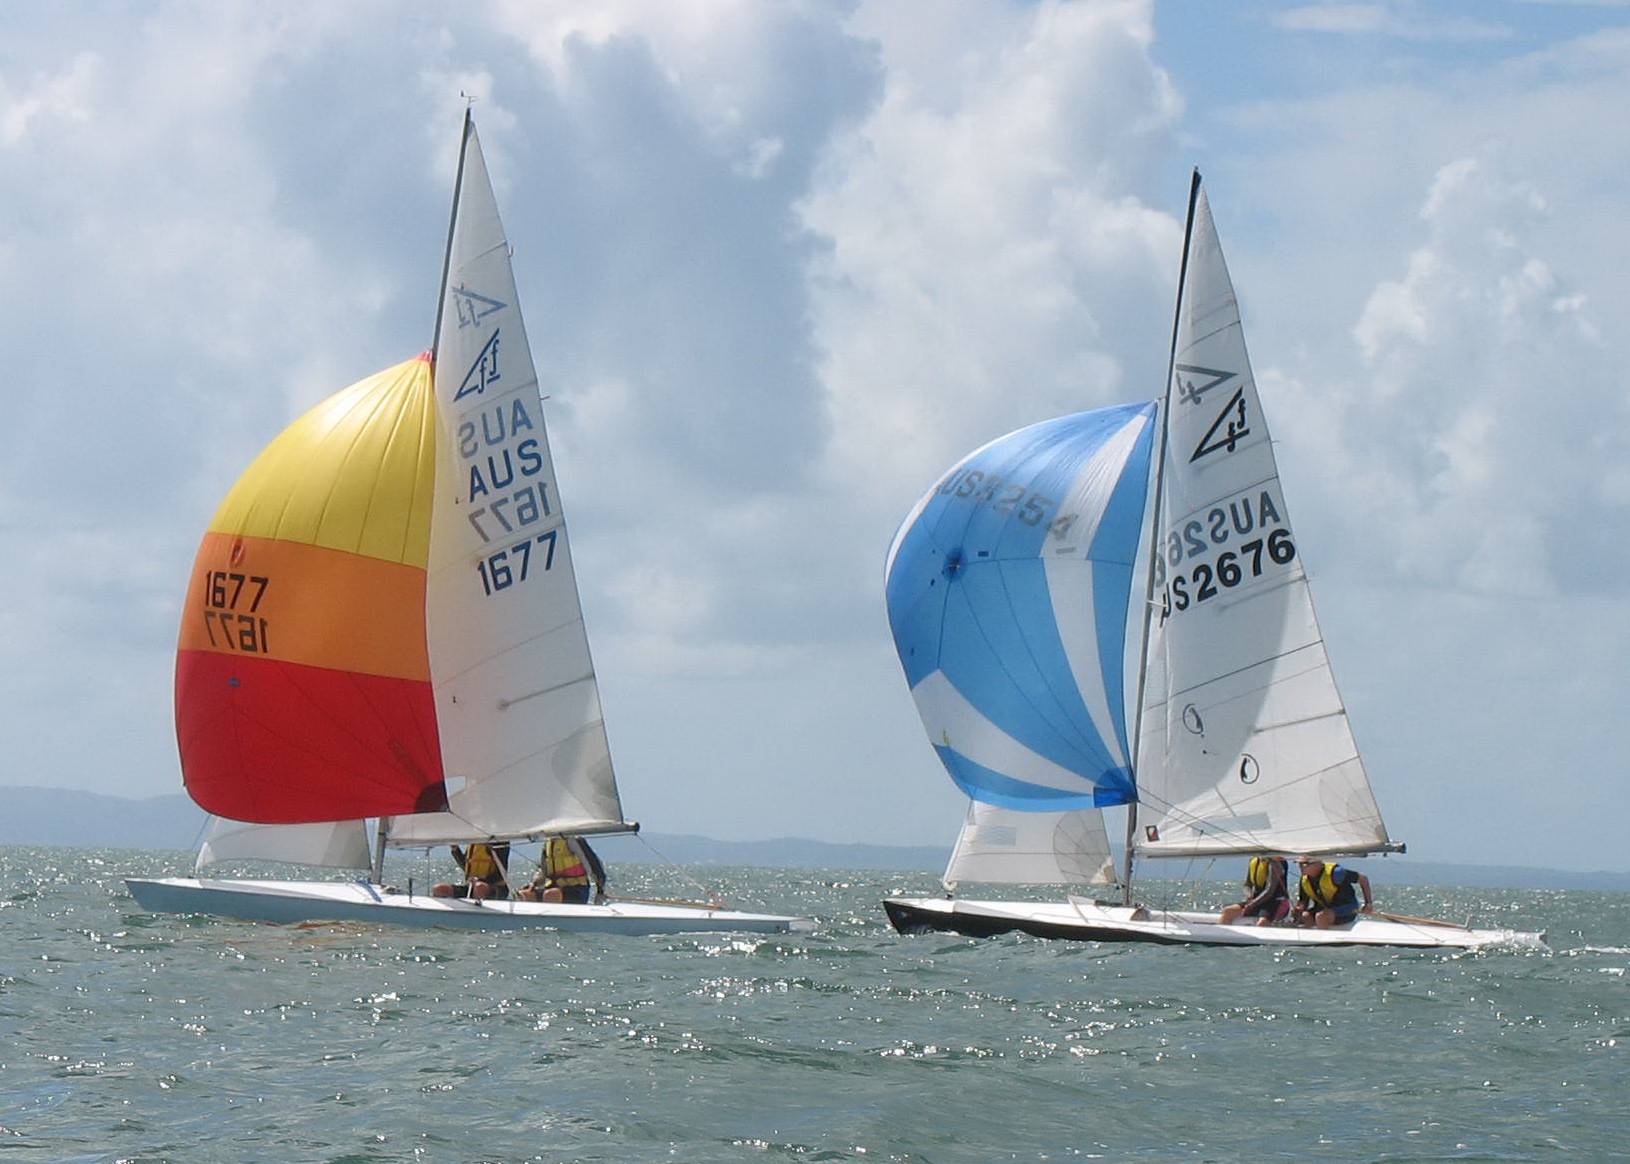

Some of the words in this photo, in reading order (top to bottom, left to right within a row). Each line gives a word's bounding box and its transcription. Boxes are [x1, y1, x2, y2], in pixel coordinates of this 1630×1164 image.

[469, 438, 542, 503] AUS
[205, 570, 269, 613] 1677
[477, 530, 558, 597] 1677
